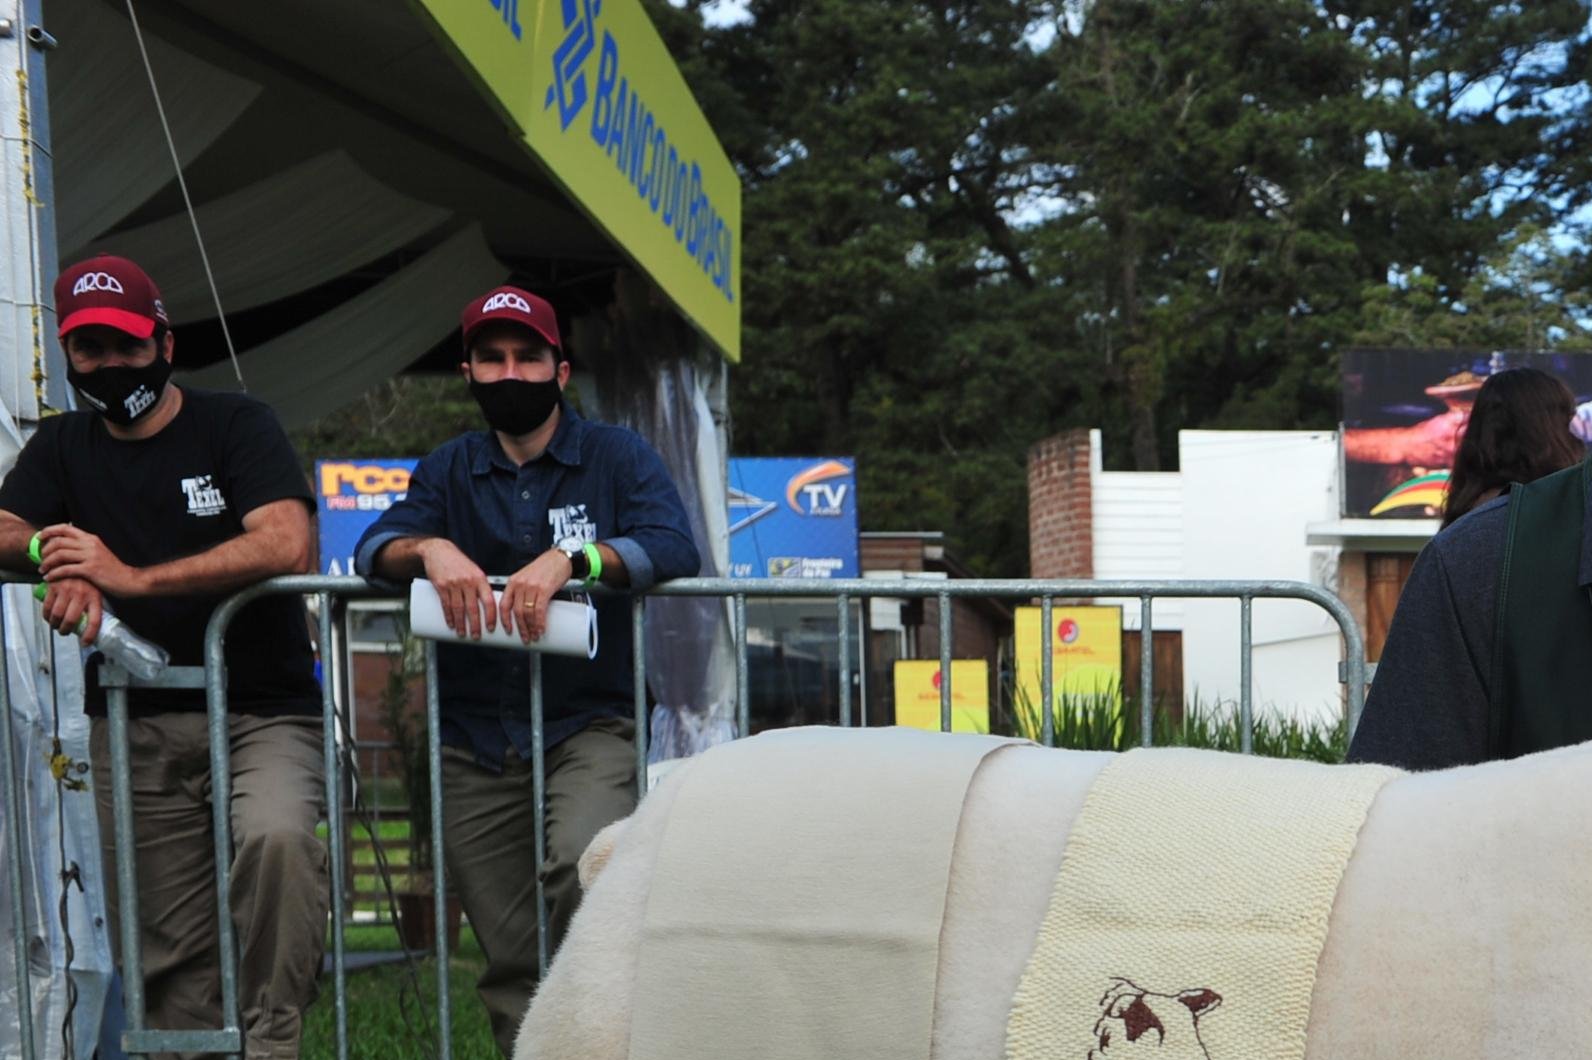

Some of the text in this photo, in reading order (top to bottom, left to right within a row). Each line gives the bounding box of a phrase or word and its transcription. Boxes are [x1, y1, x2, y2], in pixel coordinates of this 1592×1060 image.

[591, 28, 667, 214] BANCO
[685, 159, 735, 304] BRASIL
[181, 476, 226, 510] TEXEL
[803, 484, 847, 511] TV
